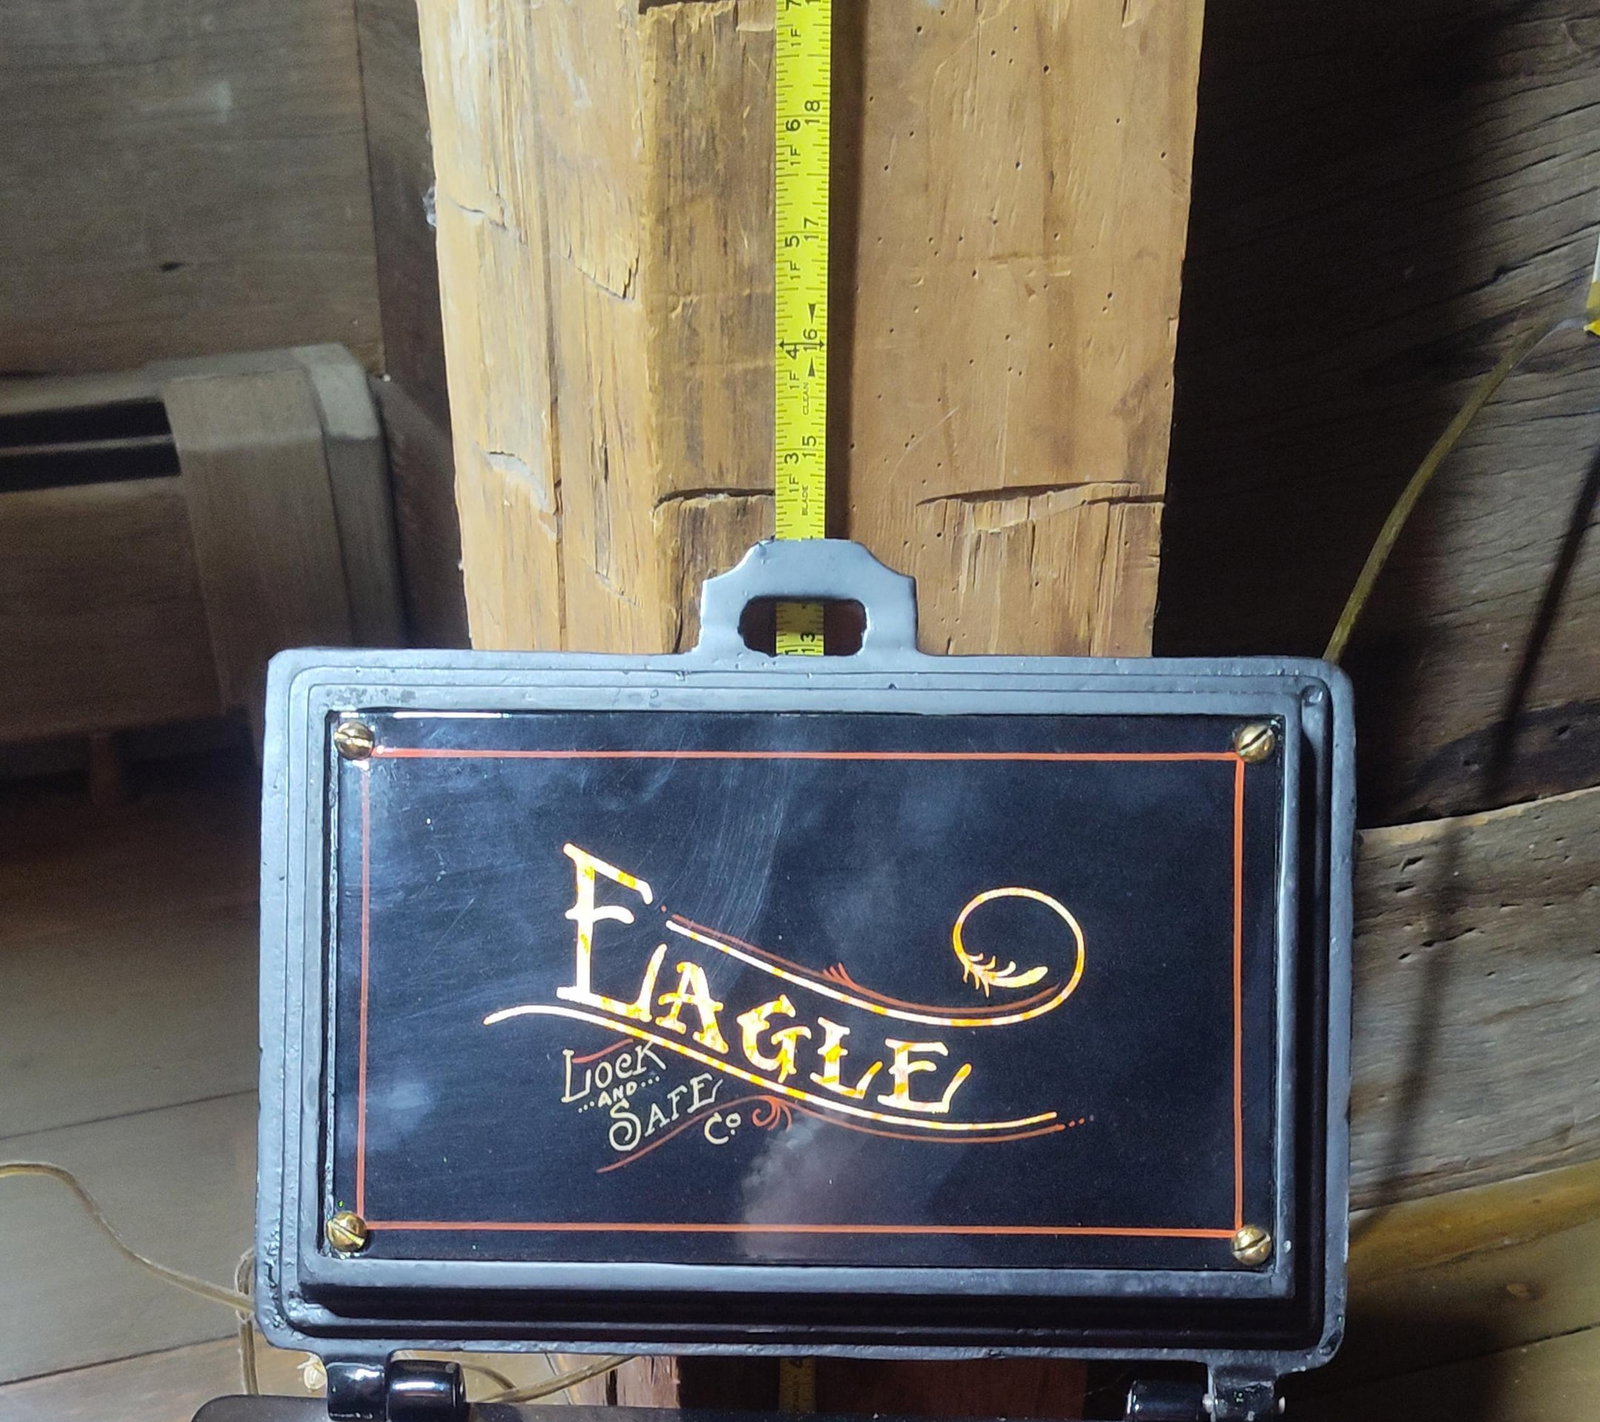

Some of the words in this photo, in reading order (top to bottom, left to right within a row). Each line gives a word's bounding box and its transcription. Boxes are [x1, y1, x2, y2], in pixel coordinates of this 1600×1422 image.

[785, 118, 801, 132] 6
[804, 100, 820, 126] 18
[803, 216, 819, 241] 17
[784, 235, 800, 248] 5
[785, 344, 800, 360] 4
[803, 328, 818, 352] 16
[784, 452, 799, 464] 3
[802, 435, 817, 459] 15
[556, 842, 972, 1113] EAGLE
[609, 1073, 724, 1151] SAFE
